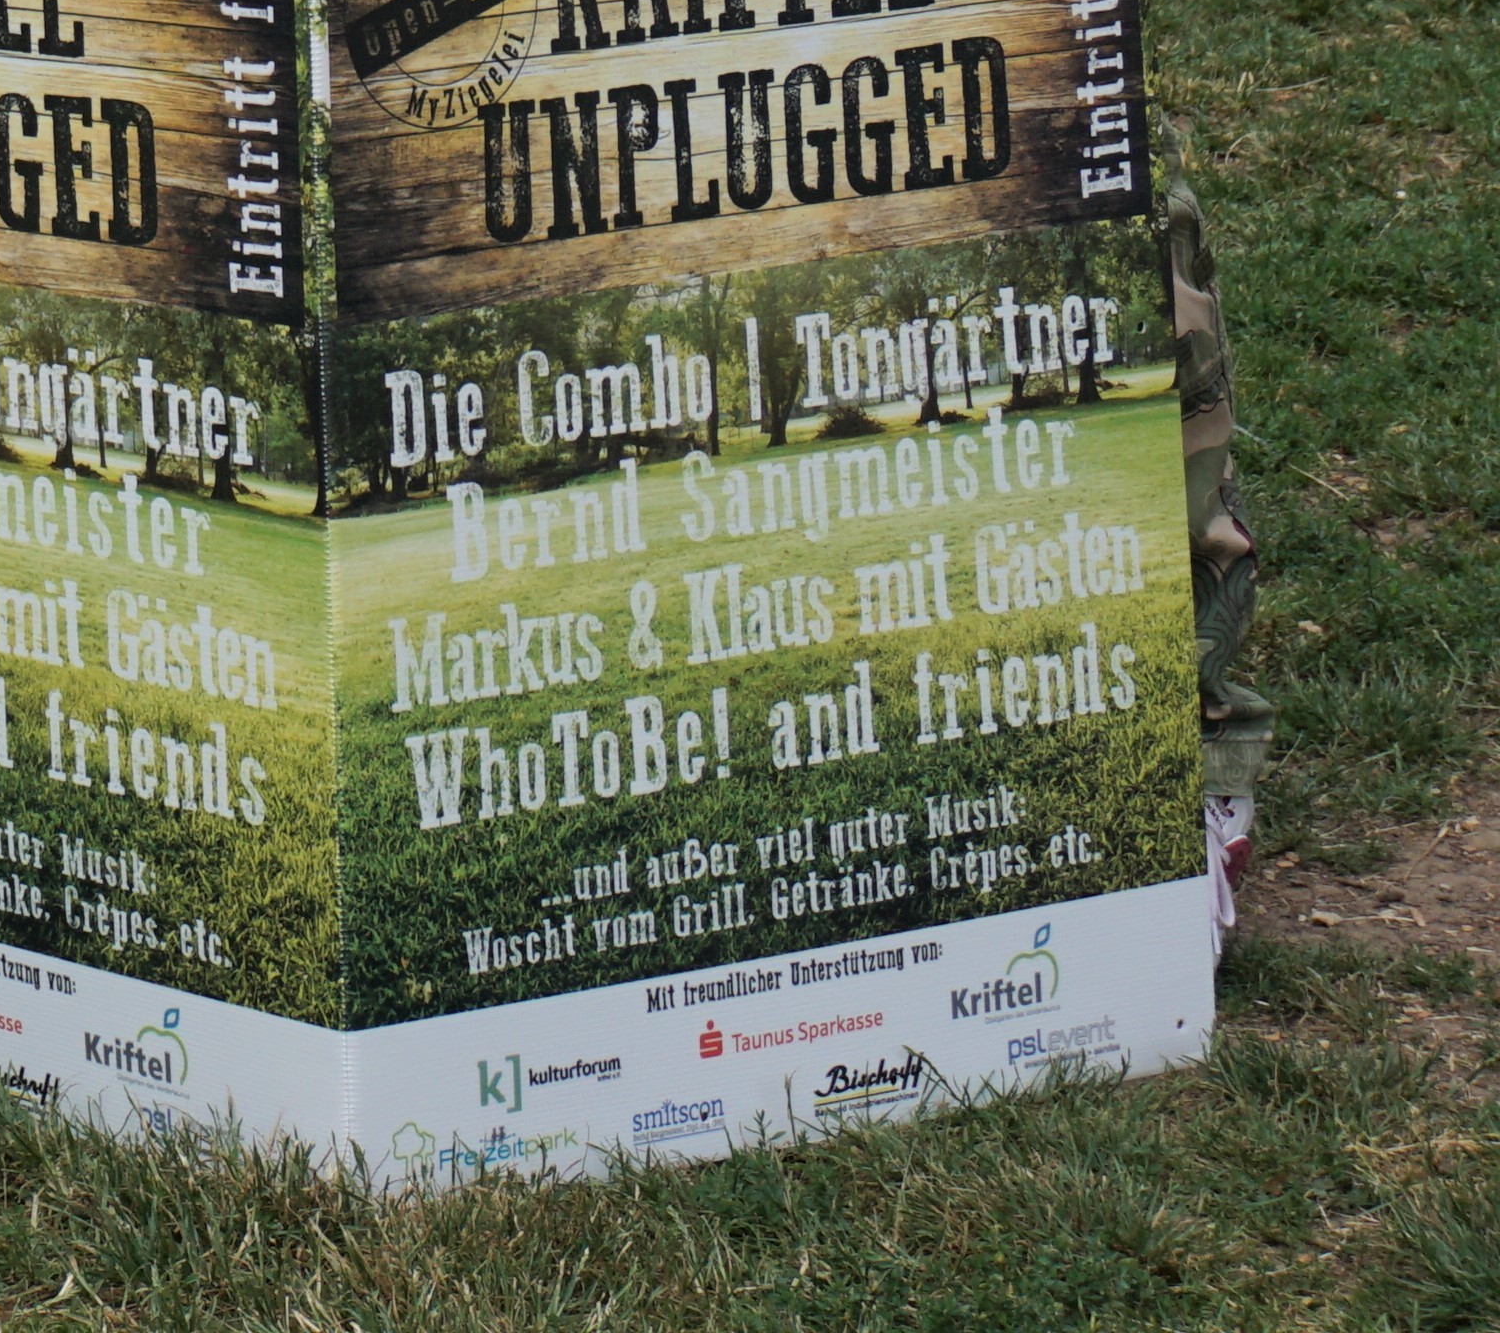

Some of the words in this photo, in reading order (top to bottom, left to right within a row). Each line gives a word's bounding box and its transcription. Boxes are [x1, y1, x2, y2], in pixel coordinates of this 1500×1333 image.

[477, 36, 1012, 241] UNPLUGGED
[446, 456, 646, 583] Bernd
[678, 406, 1078, 544] Sangmeister
[405, 683, 731, 832] WhoToBe!
[766, 657, 880, 771] and
[911, 620, 1139, 744] friends
[462, 913, 576, 977] Woscht
[592, 907, 657, 953] vom
[1049, 822, 1102, 870] etc.
[646, 983, 675, 1014] Mit
[683, 967, 782, 1006] freundlicher
[790, 949, 905, 984] Unterstützung
[912, 940, 943, 964] von:
[731, 1027, 794, 1054] Taunus
[797, 1013, 883, 1044] Sparkasse
[83, 1026, 172, 1087] Kriftel
[528, 1056, 621, 1088] kulturforum
